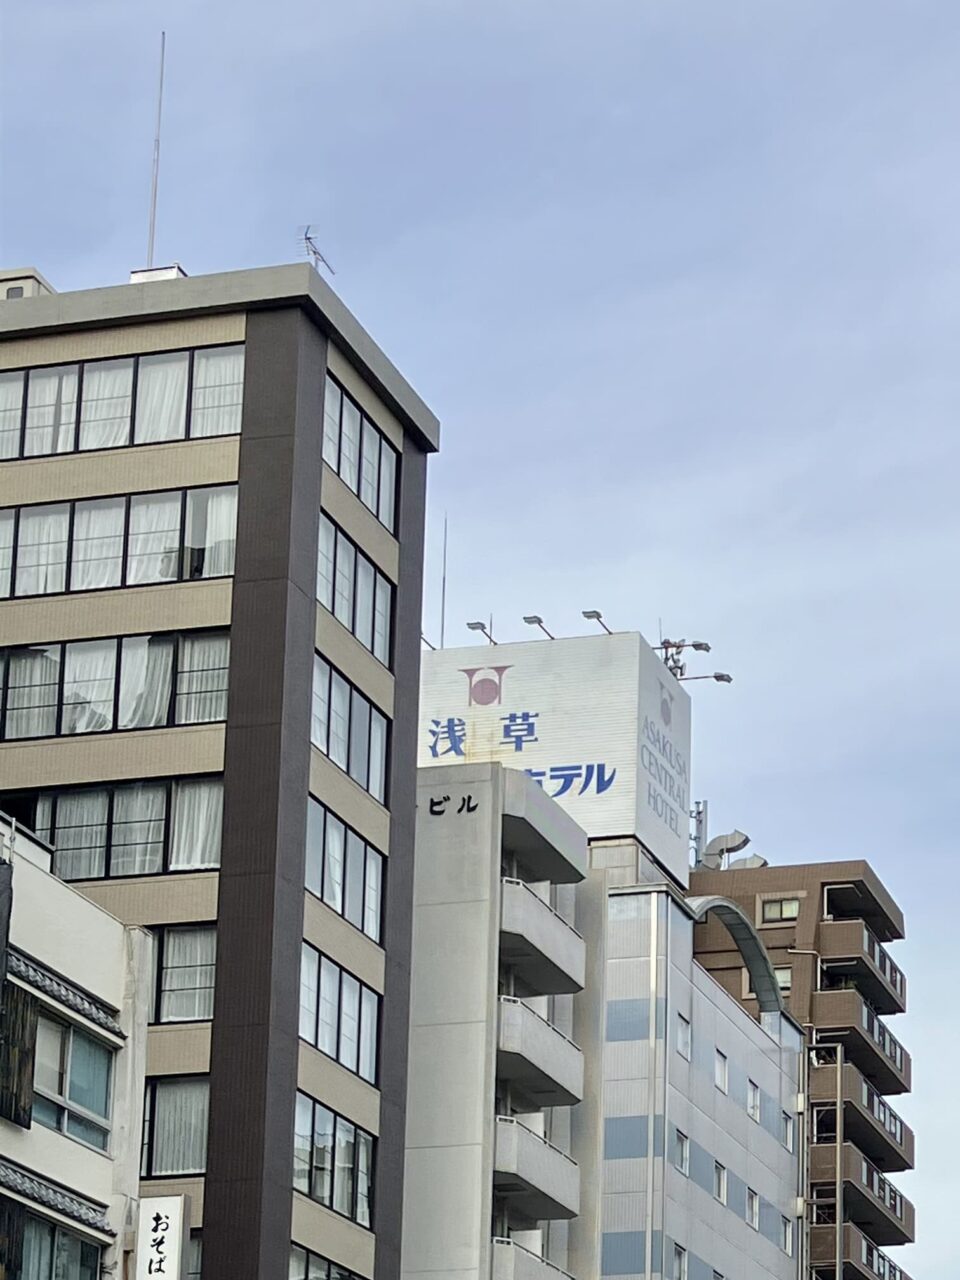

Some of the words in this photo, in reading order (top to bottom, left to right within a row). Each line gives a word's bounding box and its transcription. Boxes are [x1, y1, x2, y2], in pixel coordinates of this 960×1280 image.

[429, 712, 539, 757] 浅草
[642, 715, 688, 784] ASAKUSA
[641, 744, 688, 815] CENTRAL
[648, 782, 681, 839] HOTEL
